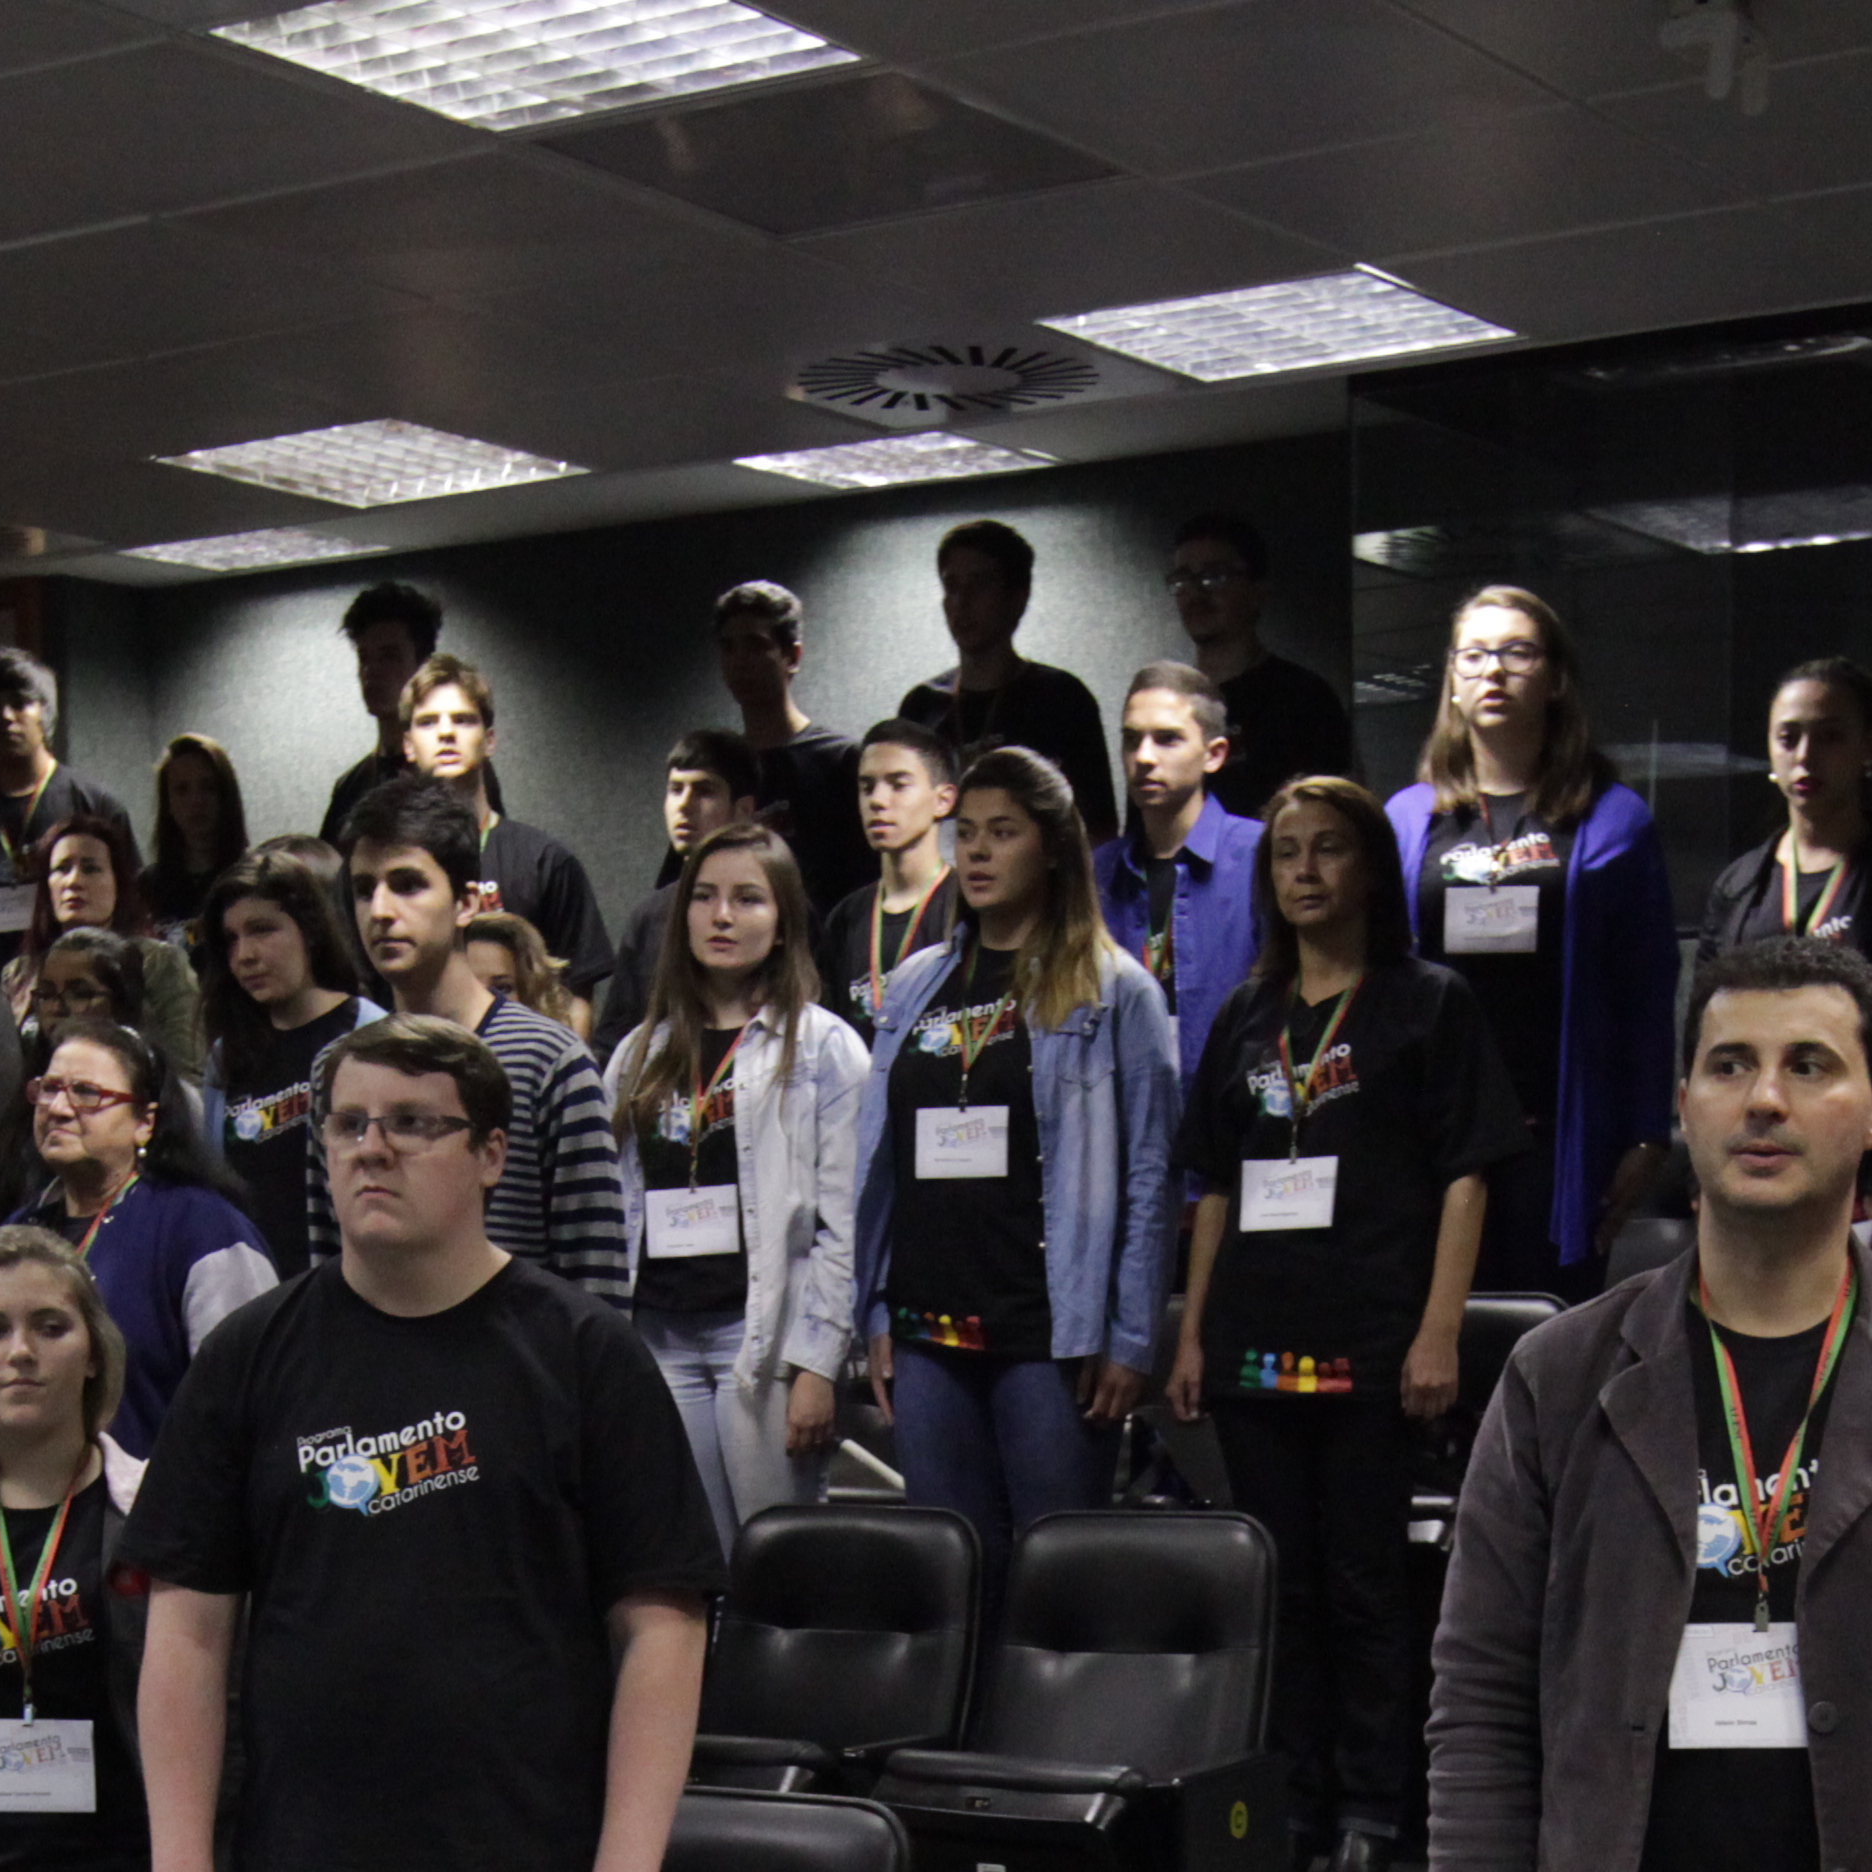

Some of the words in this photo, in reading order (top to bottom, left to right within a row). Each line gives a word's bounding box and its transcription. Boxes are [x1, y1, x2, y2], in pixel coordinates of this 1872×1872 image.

[296, 1426, 352, 1448] Programa
[298, 1411, 467, 1474] Parlamento
[306, 1429, 477, 1509] JOVEM
[367, 1465, 481, 1515] catarinense
[1233, 1811, 1244, 1829] C
